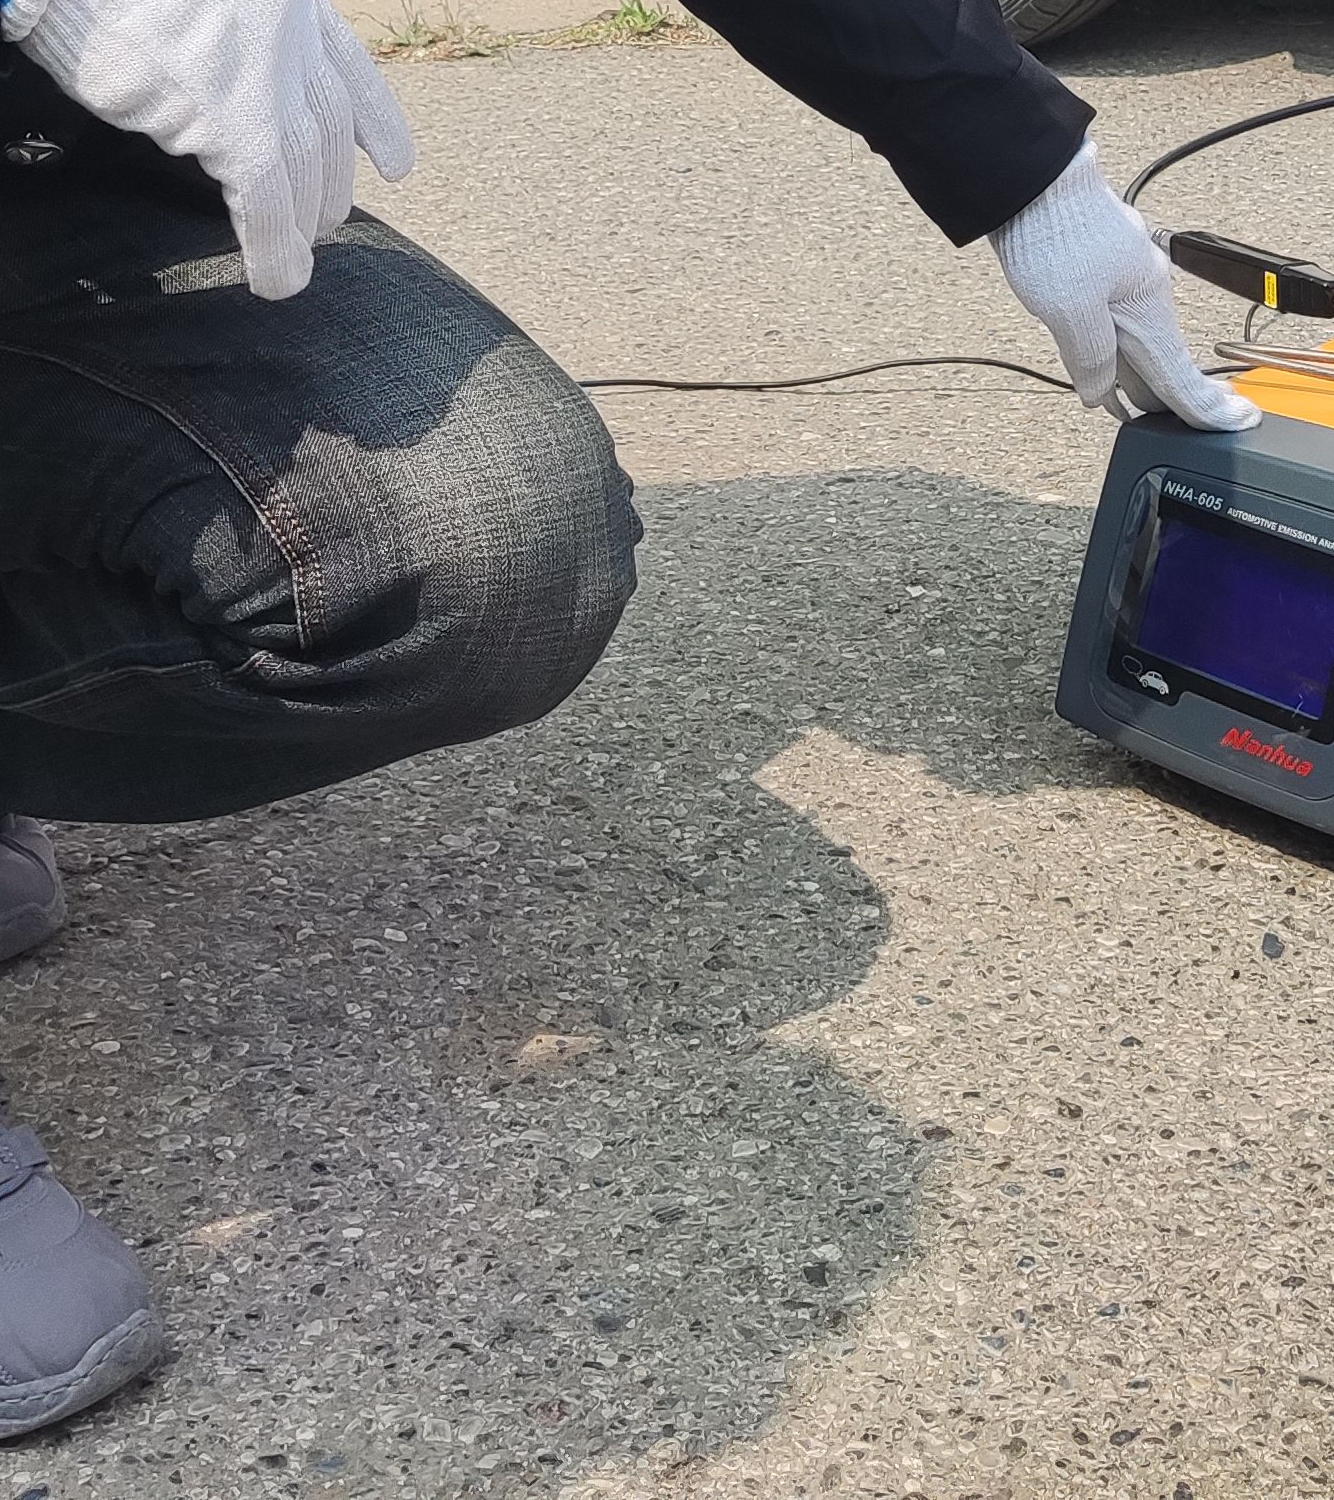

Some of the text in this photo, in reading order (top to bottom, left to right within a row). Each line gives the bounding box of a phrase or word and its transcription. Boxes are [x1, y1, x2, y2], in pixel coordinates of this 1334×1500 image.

[1163, 480, 1224, 512] NHA-605
[1227, 507, 1276, 531] AUTOMOTIVE
[1277, 524, 1318, 545] EMISSION
[1219, 726, 1314, 778] Nanhua
